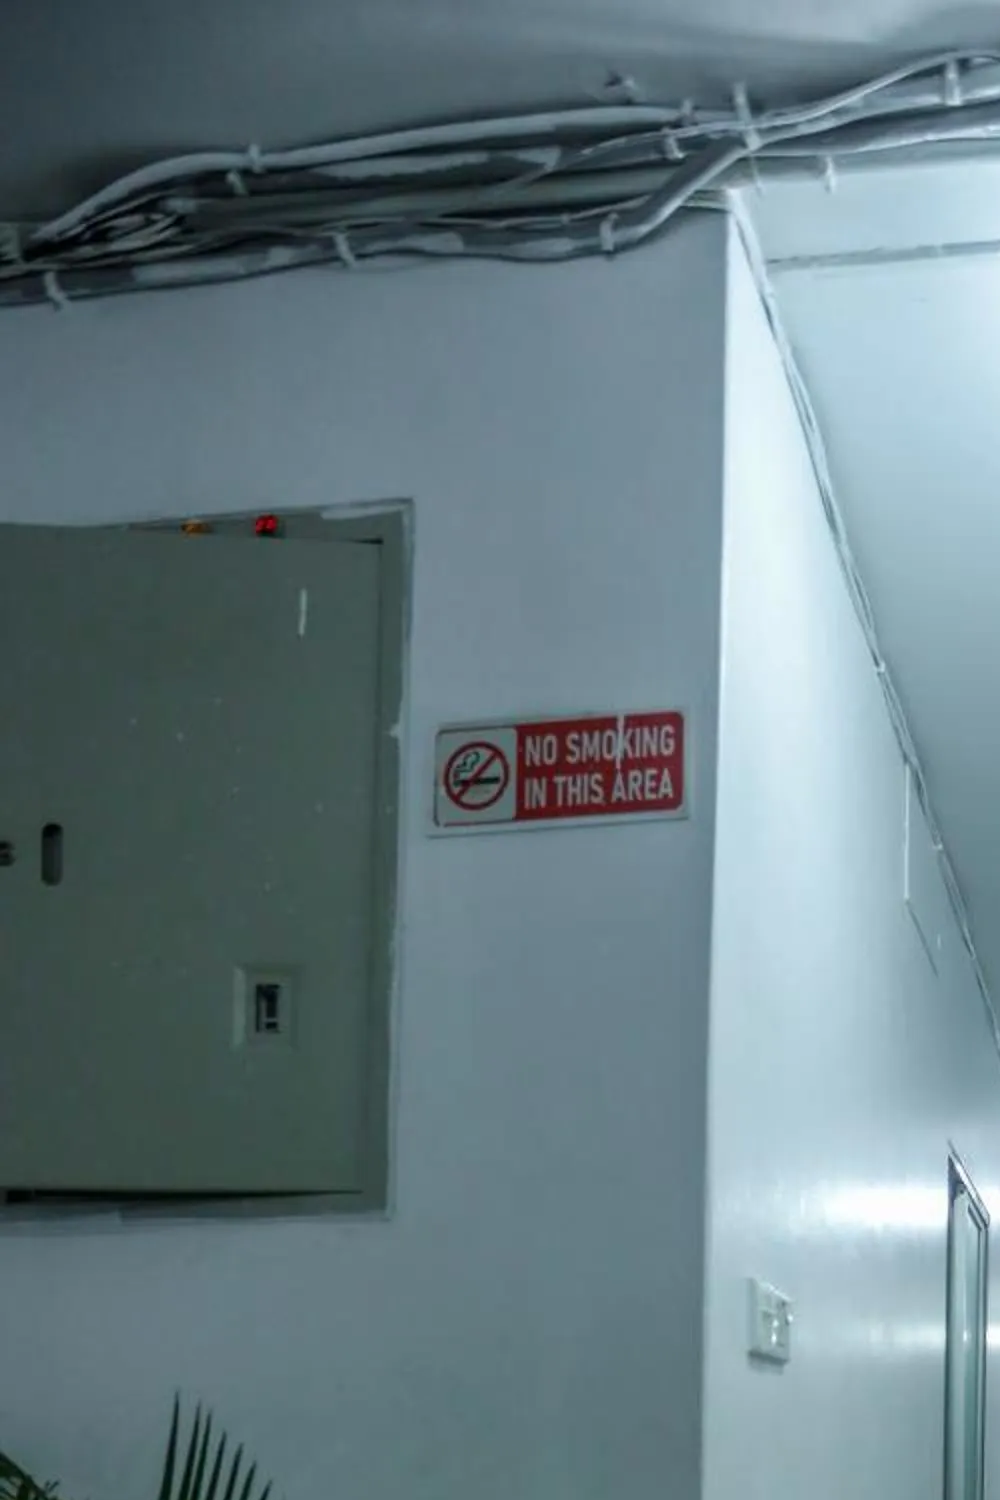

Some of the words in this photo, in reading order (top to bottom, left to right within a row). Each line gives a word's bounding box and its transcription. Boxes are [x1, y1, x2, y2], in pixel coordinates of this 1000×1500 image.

[525, 735, 557, 766] NO
[566, 724, 675, 764] SMOKING
[525, 777, 548, 809] IN
[553, 774, 604, 806] THIS
[612, 767, 674, 803] AREA
